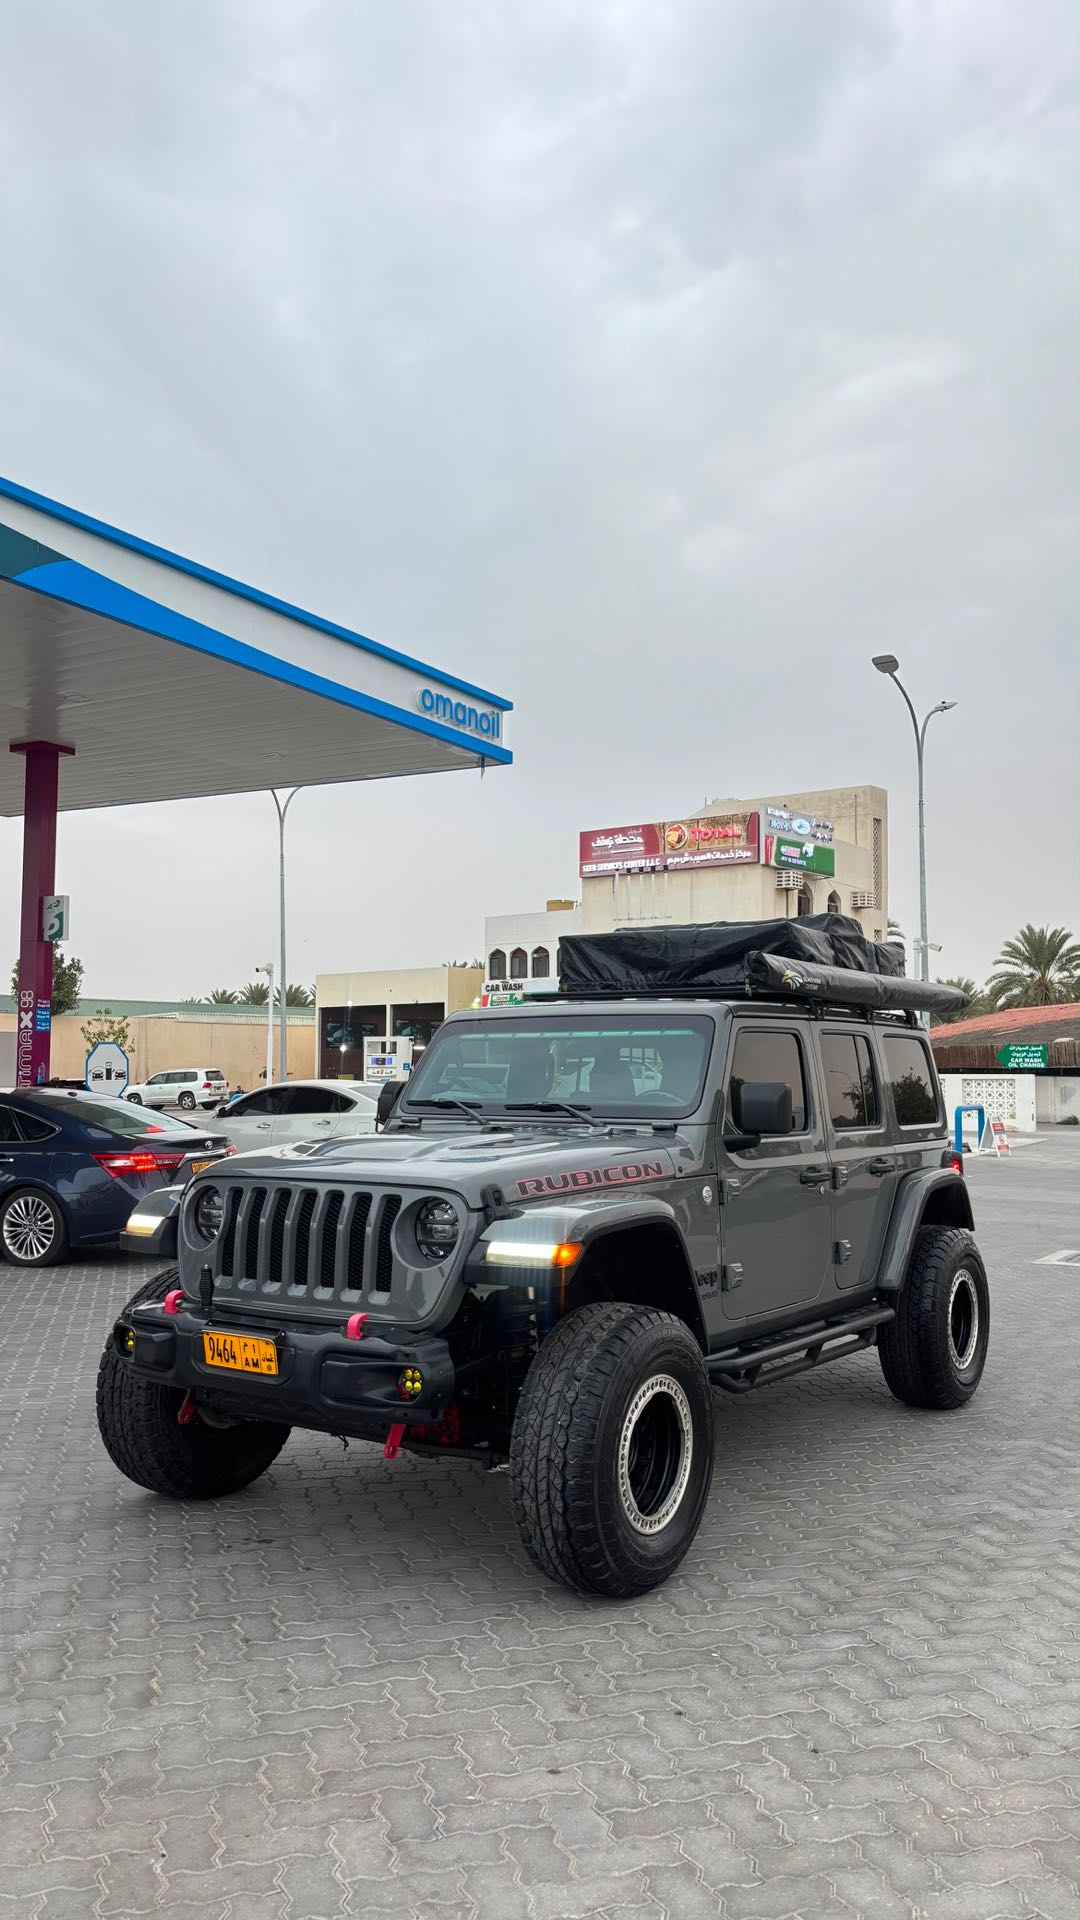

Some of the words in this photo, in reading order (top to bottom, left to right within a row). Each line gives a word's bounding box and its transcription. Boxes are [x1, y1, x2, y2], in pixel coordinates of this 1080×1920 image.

[420, 688, 500, 739] omanoil
[690, 825, 741, 840] TOTAL
[624, 860, 646, 868] CENTER
[485, 984, 500, 992] CAR
[502, 983, 523, 991] WASH
[20, 990, 34, 1008] 98
[515, 1161, 665, 1198] RUBICON
[209, 1336, 237, 1364] 9464
